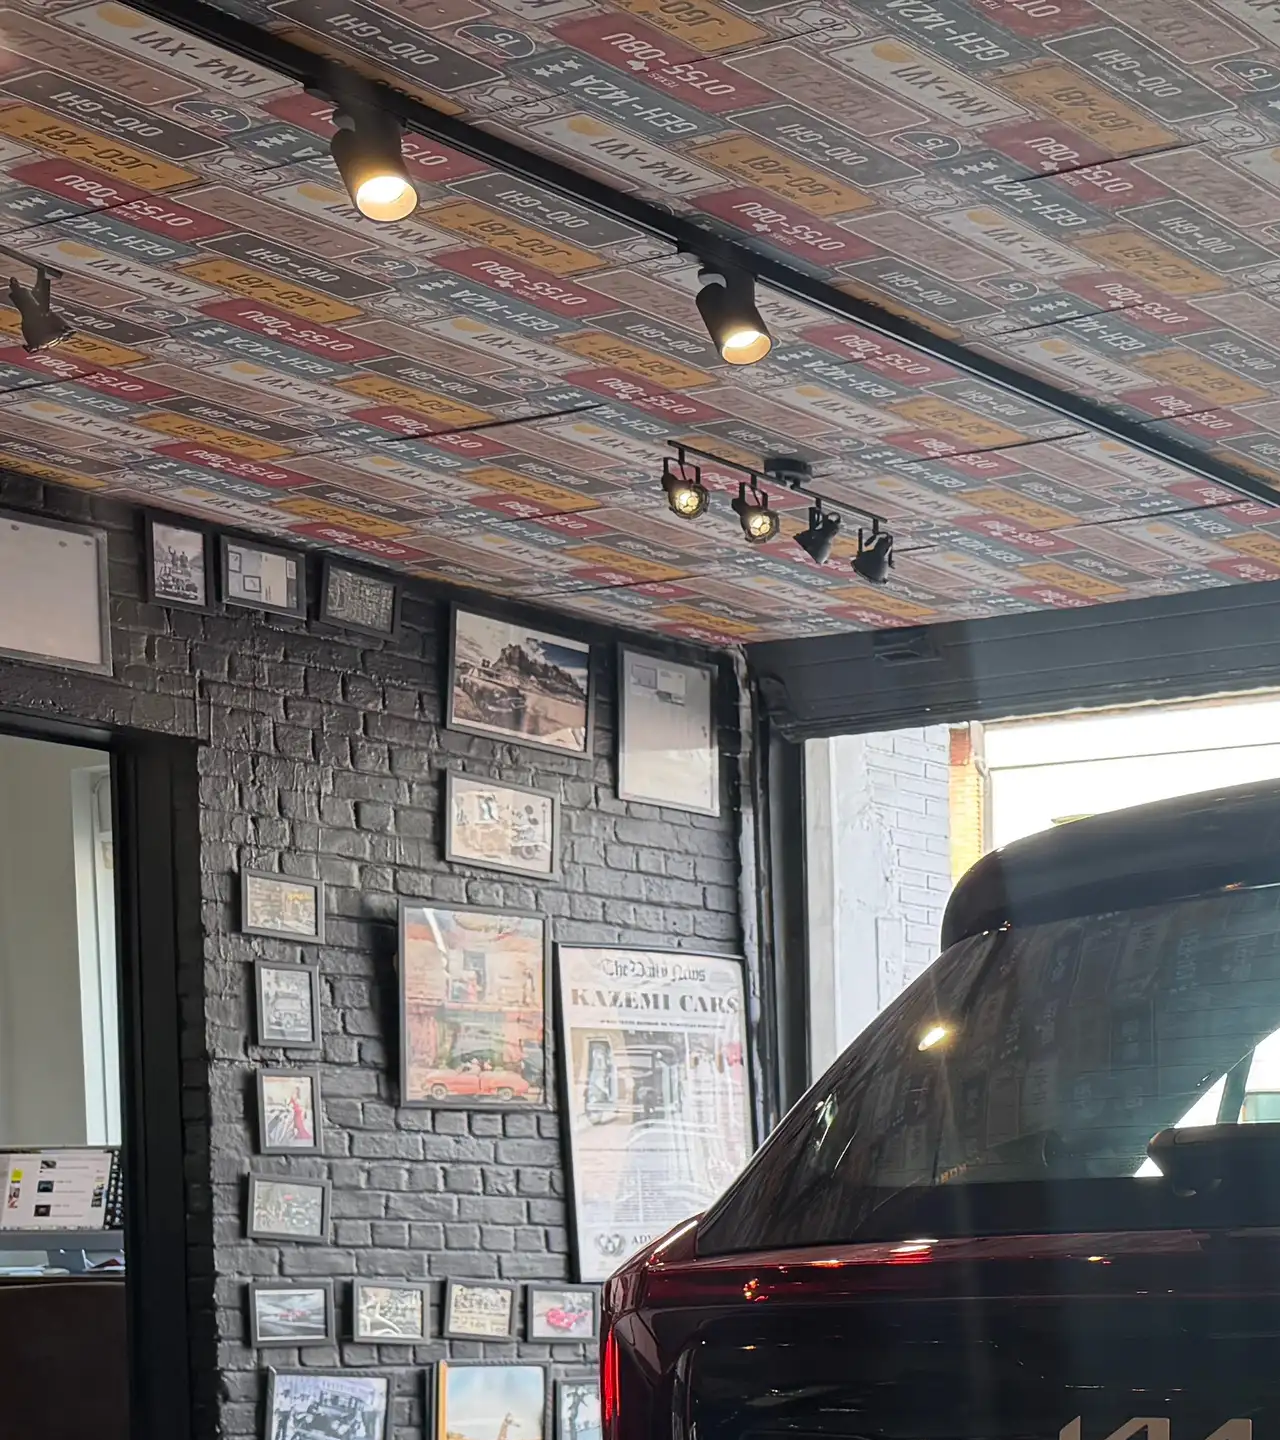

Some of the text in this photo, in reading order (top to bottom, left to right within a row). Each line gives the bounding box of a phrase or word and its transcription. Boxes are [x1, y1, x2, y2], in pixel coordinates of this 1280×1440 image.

[481, 31, 525, 47] 15
[1236, 66, 1276, 81] 15
[199, 107, 240, 122] 15
[914, 136, 952, 150] 15
[571, 988, 740, 1014] KAZEMI CARS
